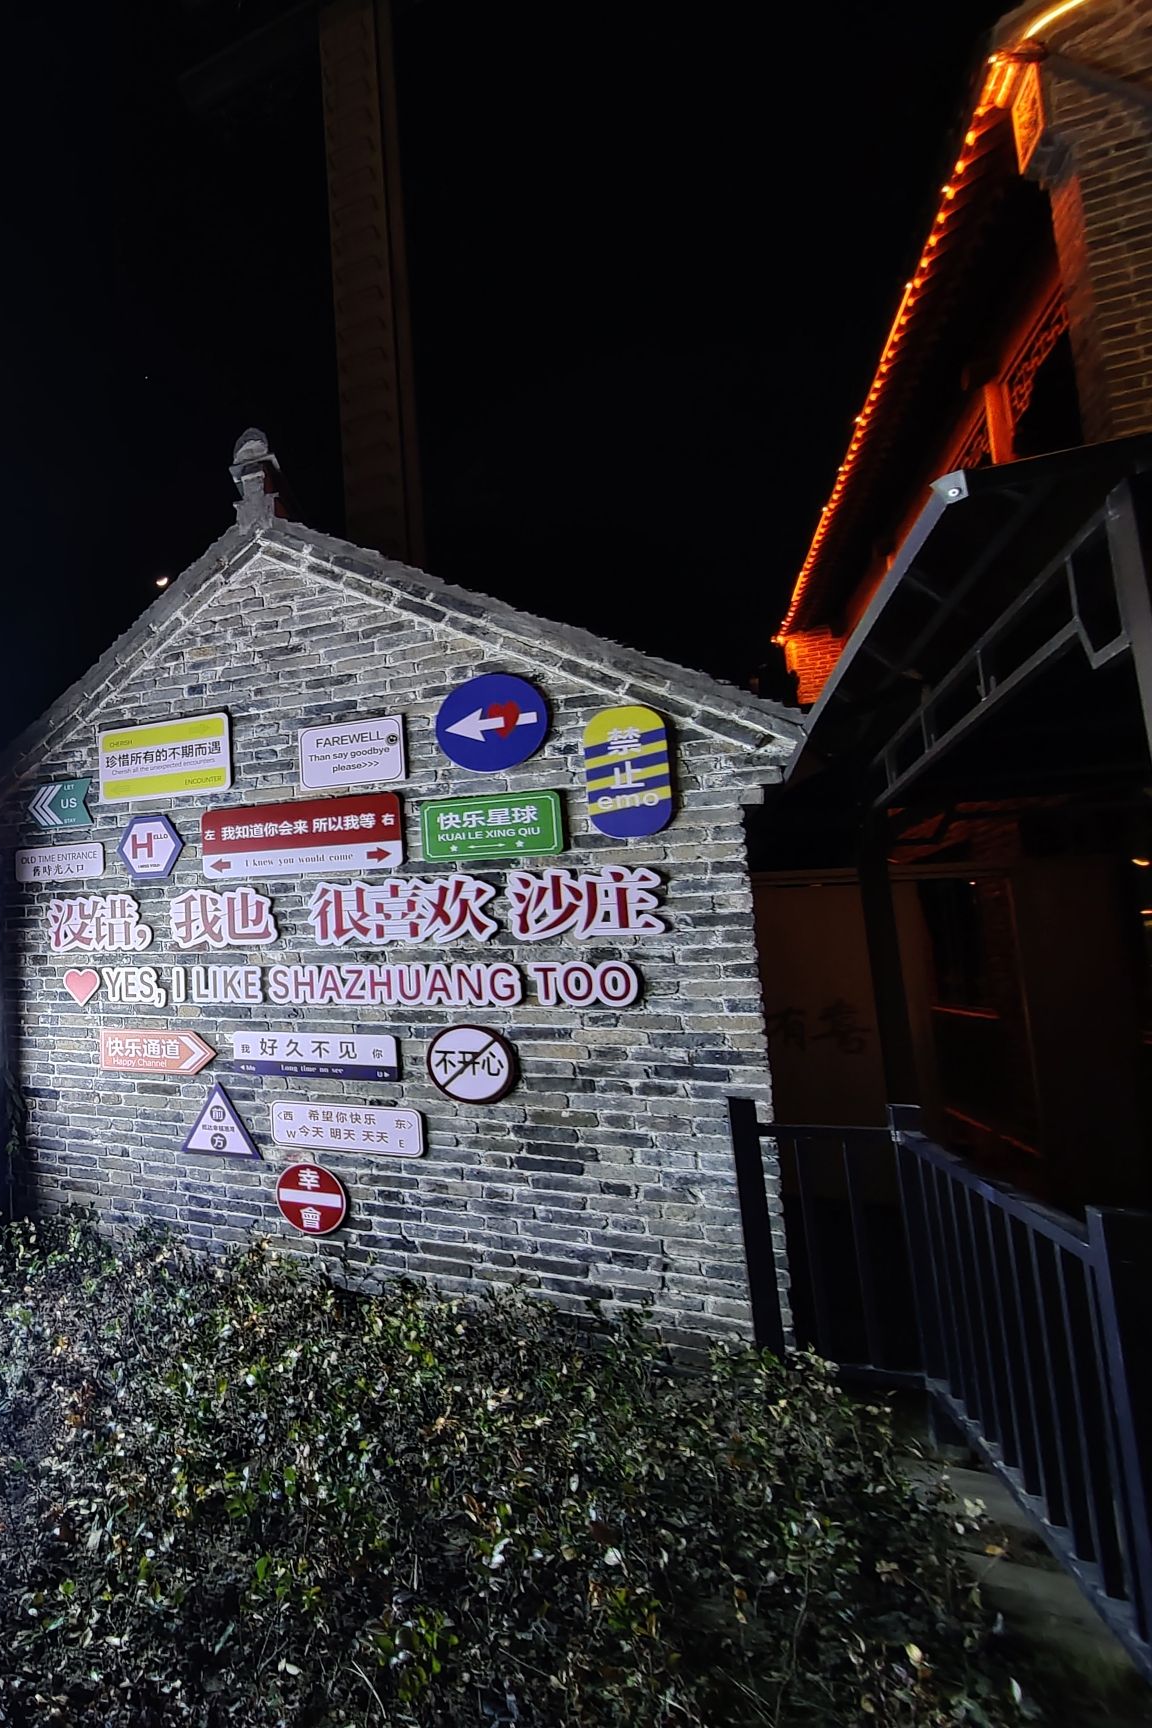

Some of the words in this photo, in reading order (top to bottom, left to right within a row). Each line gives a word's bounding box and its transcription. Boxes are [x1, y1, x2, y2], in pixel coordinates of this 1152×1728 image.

[109, 739, 133, 749] CHERISH
[315, 730, 385, 749] FAREWELL
[105, 740, 222, 769] 珍惜所有的不期而遇
[308, 753, 331, 762] Than
[332, 752, 349, 761] say
[350, 746, 390, 759] goodbye
[607, 726, 646, 790] 禁止
[184, 775, 222, 786] ENCOUNTER
[60, 798, 78, 809] US
[597, 792, 660, 810] emo
[204, 830, 216, 841] 左
[221, 819, 309, 841] 我知道你会来
[312, 812, 376, 833] 所以我等
[381, 813, 395, 827] 右
[436, 805, 539, 831] 快乐星球
[437, 832, 466, 842] KUAI
[467, 831, 484, 840] LE
[485, 828, 516, 839] XING
[518, 826, 541, 837] QIU
[21, 856, 37, 865] OLD
[38, 854, 56, 863] TIME
[57, 850, 98, 862] ENTRANCE
[252, 857, 274, 866] knew
[278, 857, 295, 866] you
[298, 853, 325, 864] would
[329, 853, 354, 862] come
[175, 891, 273, 944] 我也
[310, 879, 491, 941] 很喜欢
[513, 871, 657, 935] 沙庄
[106, 970, 166, 1005] YES,
[194, 970, 259, 1000] LIKE
[272, 967, 516, 1001] SHAZHUANG
[533, 965, 632, 1001] TOO
[106, 1036, 180, 1060] 快乐通道
[241, 1044, 251, 1054] 我
[259, 1037, 358, 1060] 好久不见
[372, 1048, 384, 1059] 你
[113, 1057, 136, 1067] Happy
[137, 1059, 167, 1068] Channel
[281, 1064, 299, 1073] Long
[300, 1065, 317, 1073] time
[434, 1050, 504, 1077] 不开心
[211, 1107, 224, 1120] 前
[283, 1110, 294, 1121] 西
[308, 1109, 377, 1126] 希望你快乐
[395, 1119, 406, 1130] 东
[212, 1135, 225, 1148] 方
[286, 1130, 296, 1139] W
[298, 1125, 324, 1139] 今天
[330, 1127, 356, 1141] 明天
[362, 1130, 389, 1144] 天天
[399, 1139, 405, 1148] E
[298, 1167, 321, 1190] 幸
[299, 1206, 322, 1230] 會
